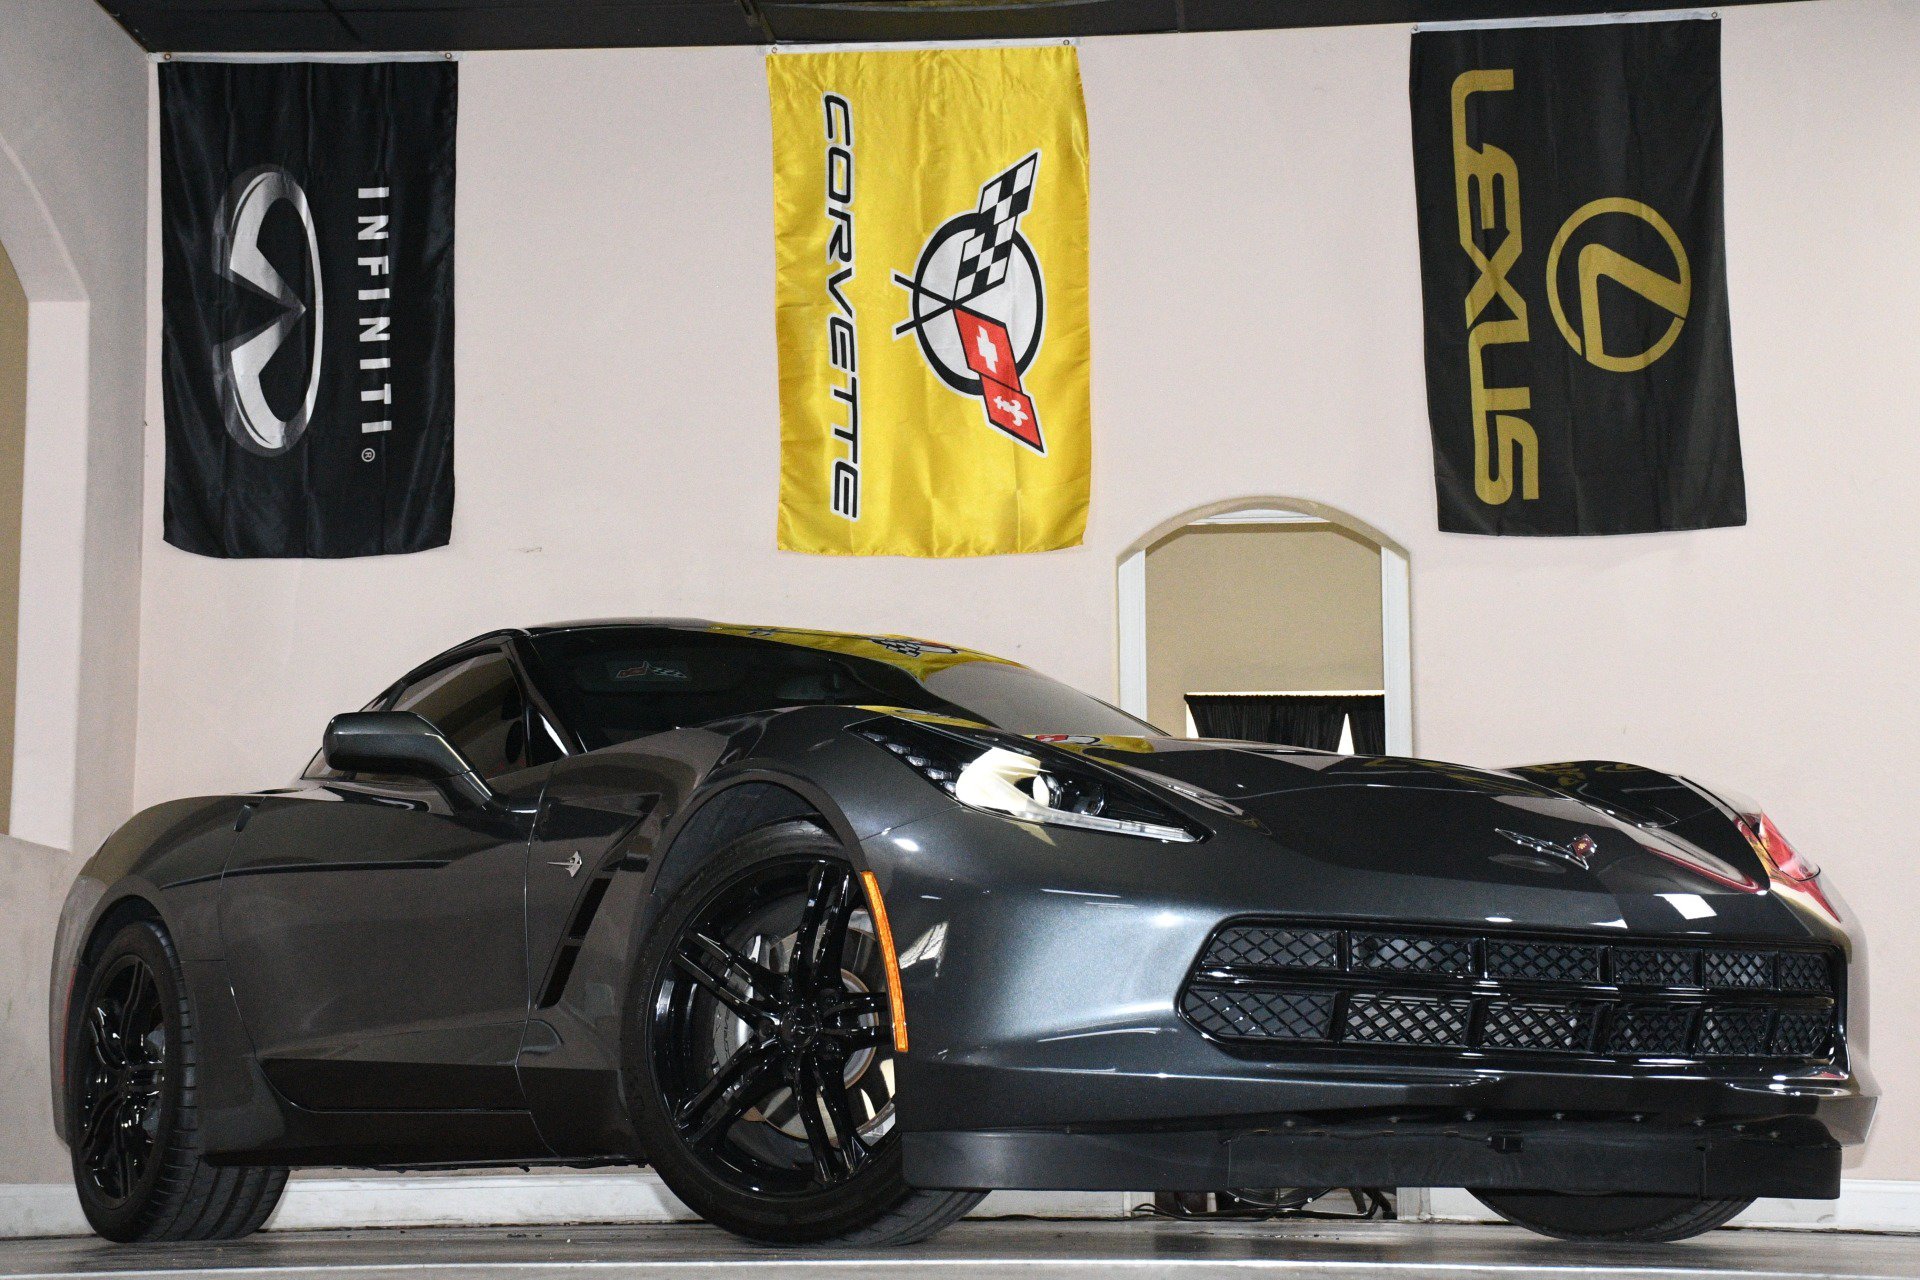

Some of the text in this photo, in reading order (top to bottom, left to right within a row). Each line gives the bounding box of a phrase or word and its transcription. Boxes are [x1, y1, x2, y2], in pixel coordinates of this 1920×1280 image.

[357, 186, 392, 434] INFINITI
[823, 91, 861, 520] CORVETTE
[1451, 68, 1539, 506] LEXUS
